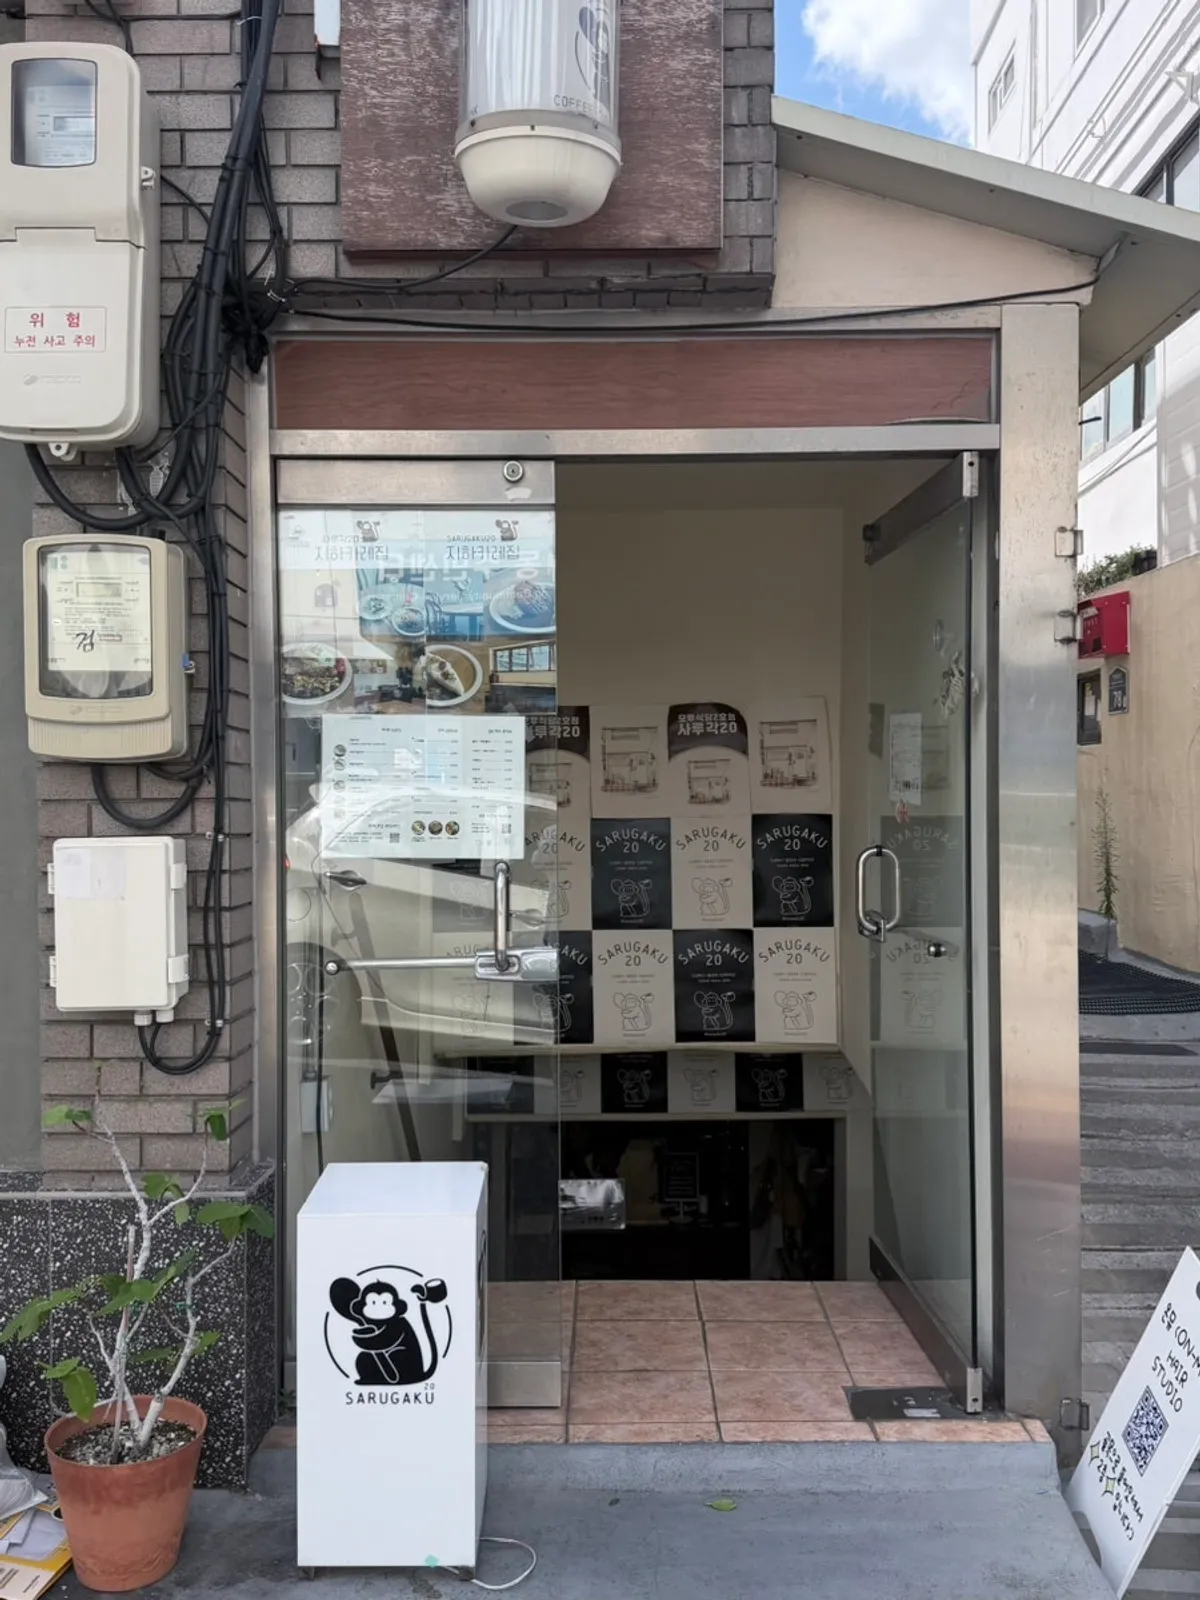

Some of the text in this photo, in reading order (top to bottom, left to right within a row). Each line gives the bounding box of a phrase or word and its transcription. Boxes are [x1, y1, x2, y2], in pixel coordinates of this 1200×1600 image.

[29, 312, 80, 328] 위 험
[14, 334, 95, 347] 누전 사고 주의
[446, 534, 497, 543] SARUGAKU20
[677, 721, 738, 736] 사루각20
[596, 828, 666, 852] SARUGAKU
[676, 826, 746, 850] SARUGAKU
[756, 825, 828, 849] SARUGAKU
[623, 841, 639, 853] 20
[703, 840, 719, 852] 20
[784, 839, 800, 851] 20
[598, 941, 669, 965] SARUGAKU
[678, 940, 749, 964] SARUGAKU
[759, 939, 830, 962] SARUGAKU
[625, 955, 641, 967] 20
[706, 954, 723, 966] 20
[786, 953, 803, 964] 20
[1167, 1350, 1188, 1388] HAIR
[424, 1382, 435, 1390] 20
[1152, 1356, 1183, 1412] STUDIO
[340, 1391, 434, 1405] SARUGAKU
